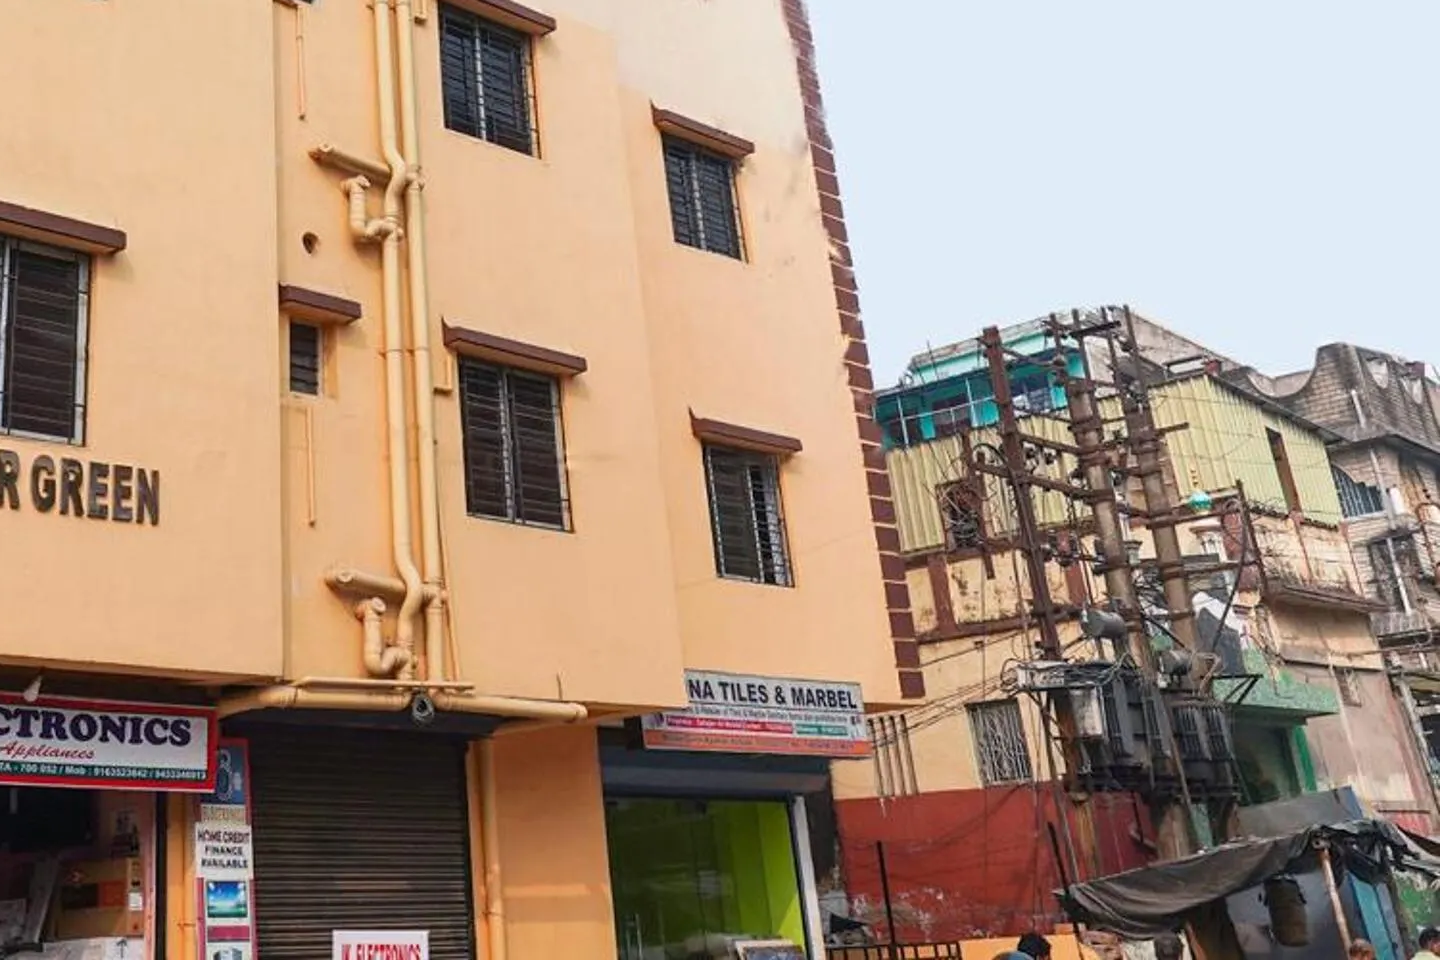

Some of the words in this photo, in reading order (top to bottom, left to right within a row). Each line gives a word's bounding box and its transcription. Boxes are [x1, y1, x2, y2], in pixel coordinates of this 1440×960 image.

[30, 454, 160, 527] GREEN
[718, 682, 769, 704] TILES
[774, 686, 787, 704] &
[791, 687, 857, 709] MARBEL
[65, 765, 86, 775] Mob
[198, 829, 221, 842] HOME
[222, 830, 250, 843] CREDIT
[204, 845, 243, 856] FINANCE
[201, 858, 248, 868] AVAILABLE
